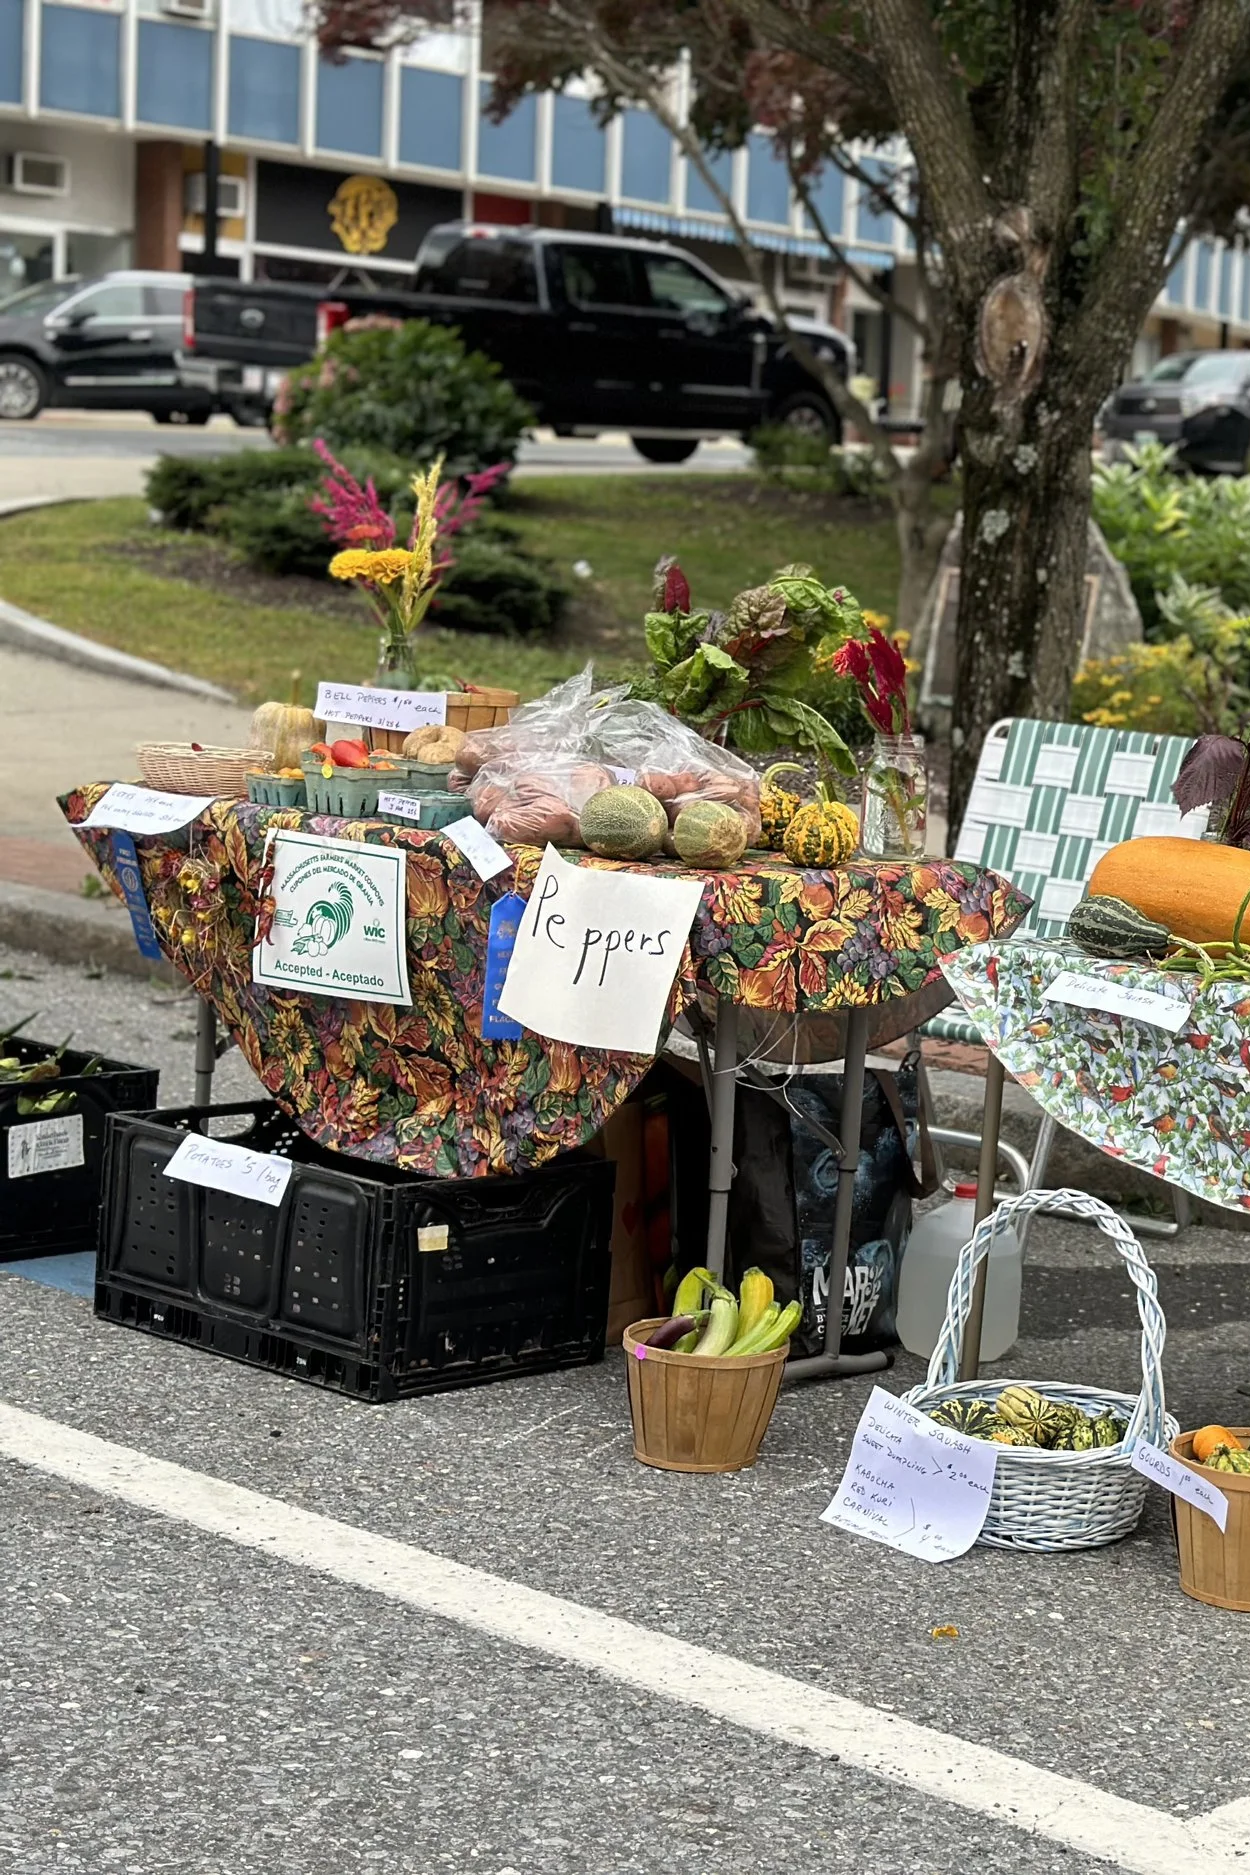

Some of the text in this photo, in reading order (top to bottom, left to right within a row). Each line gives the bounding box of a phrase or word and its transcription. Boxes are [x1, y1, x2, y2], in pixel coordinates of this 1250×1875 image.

[324, 689, 352, 701] BELL
[280, 854, 319, 891] MASSACHUSETTS
[344, 857, 365, 877] MARKET
[364, 875, 385, 907] COUPONS
[289, 872, 312, 893] CUPONES
[323, 865, 349, 878] MERCADO
[349, 873, 356, 883] DE
[363, 925, 386, 938] WIC
[275, 959, 323, 978] Accepted
[332, 969, 384, 987] Aceptado
[884, 1400, 972, 1454] WINTER SQUASH
[862, 1434, 884, 1451] SWEET
[887, 1446, 927, 1475] DUMPLING
[1138, 1446, 1171, 1477] GOURDS
[850, 1482, 865, 1496] RED
[855, 1464, 895, 1490] KABOCHA
